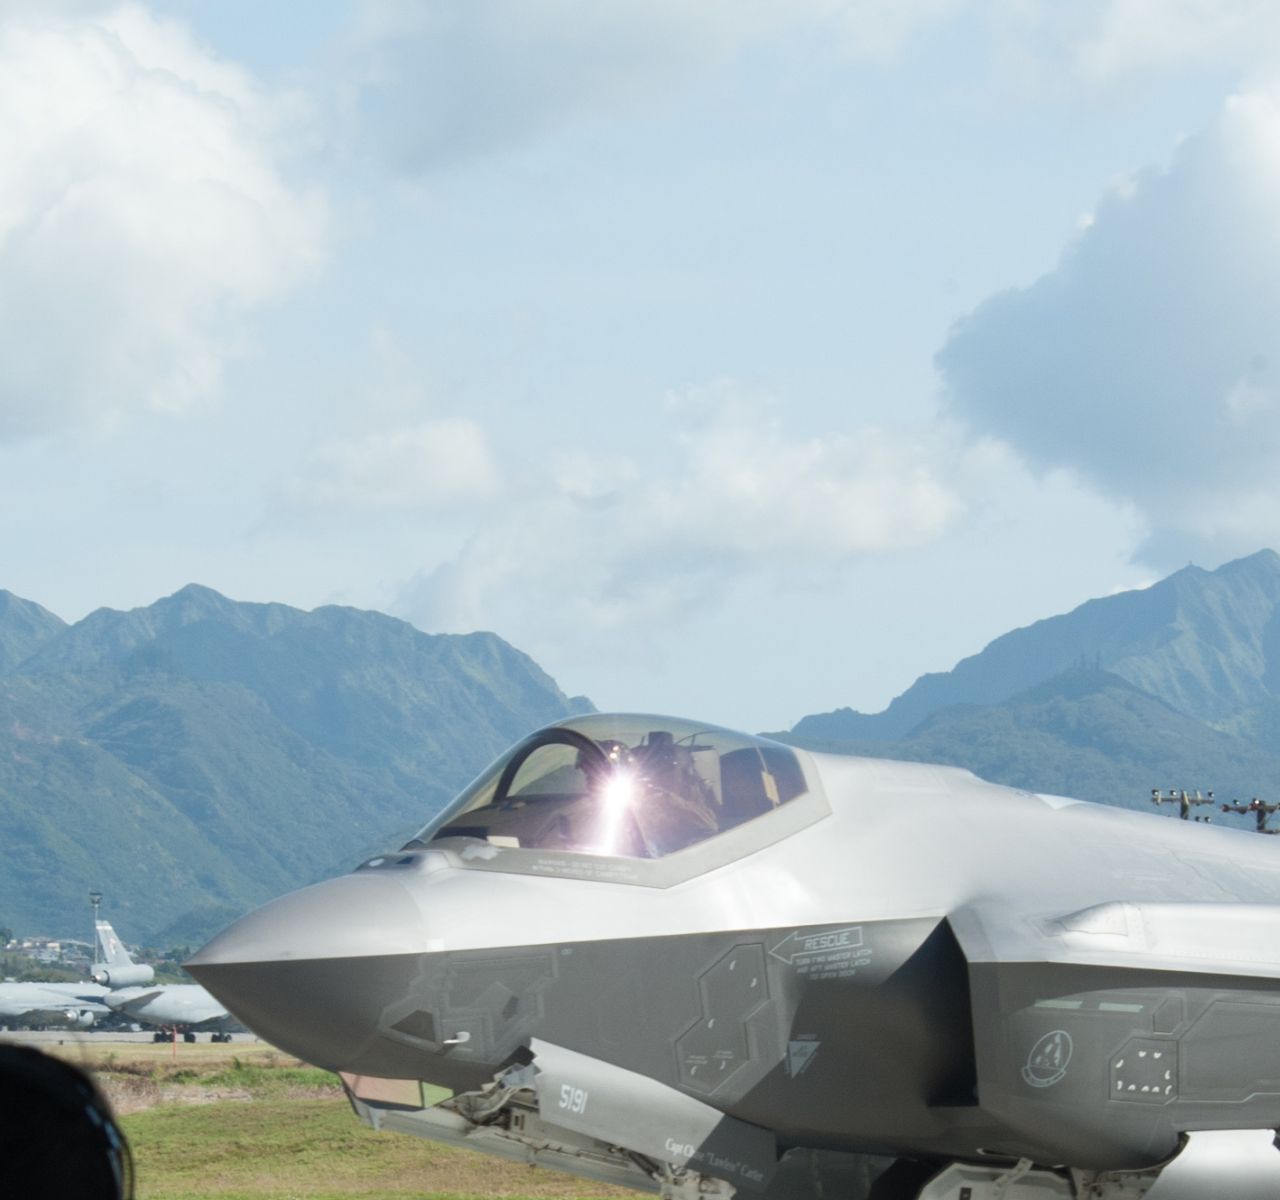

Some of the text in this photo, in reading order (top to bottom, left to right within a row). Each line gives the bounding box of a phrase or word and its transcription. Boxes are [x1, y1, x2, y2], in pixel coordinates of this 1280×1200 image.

[803, 932, 850, 951] RESCUE
[559, 1084, 589, 1114] 5191
[665, 1137, 684, 1157] Capt
